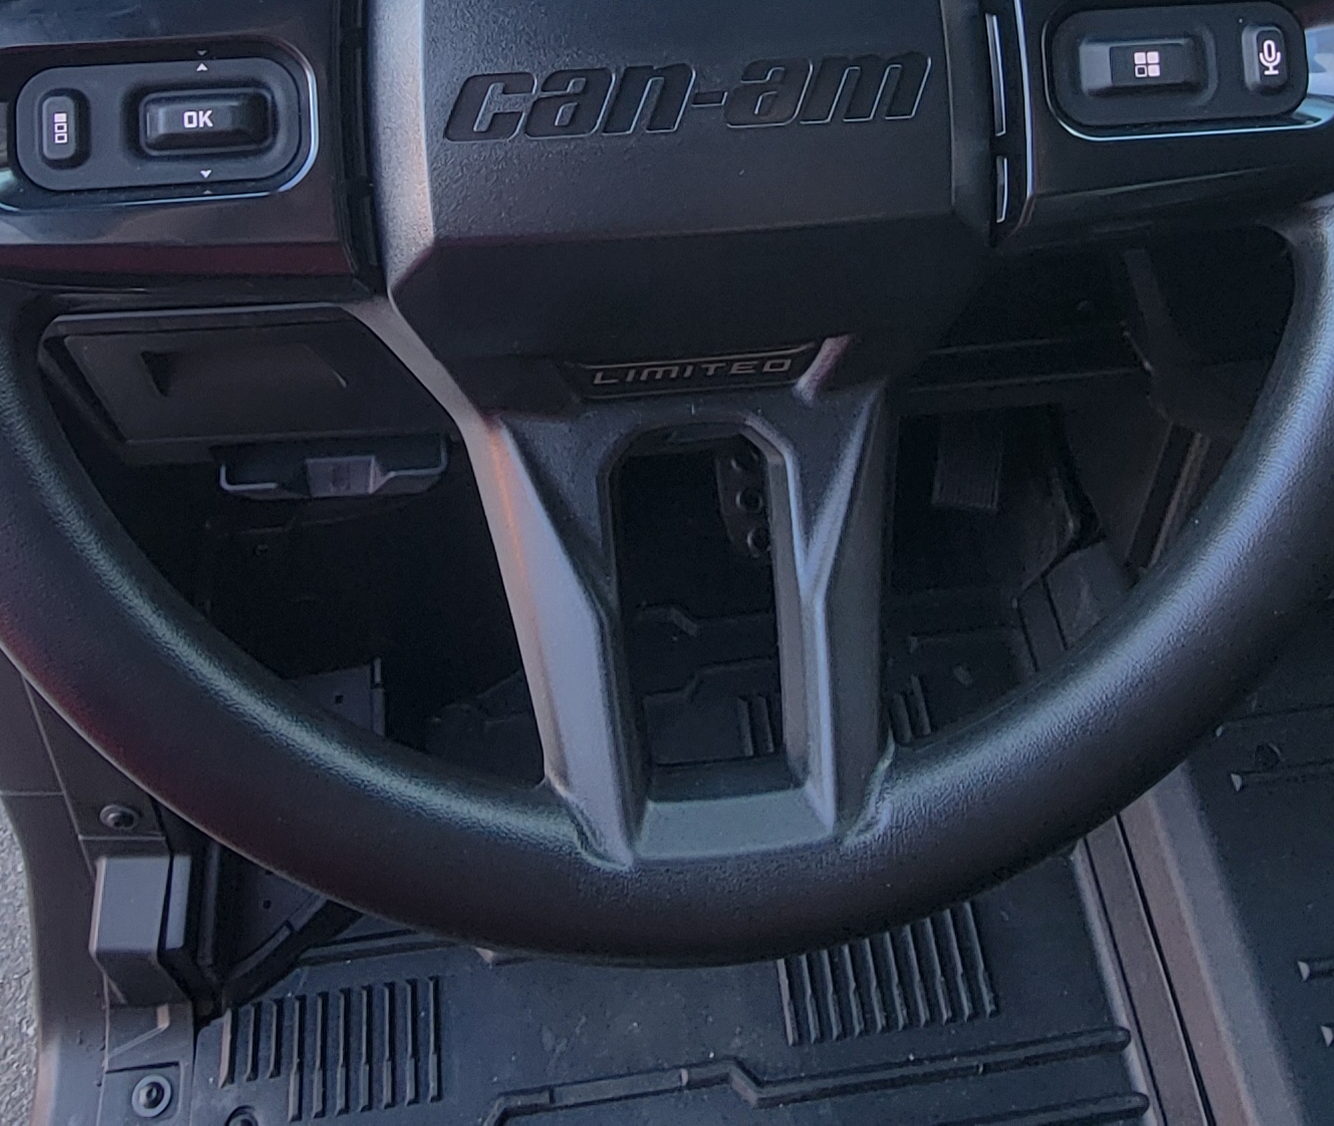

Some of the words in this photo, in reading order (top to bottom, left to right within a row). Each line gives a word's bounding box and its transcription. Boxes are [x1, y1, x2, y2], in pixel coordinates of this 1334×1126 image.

[444, 51, 932, 143] can-am
[183, 110, 214, 129] OK
[593, 358, 792, 385] LIMITED
